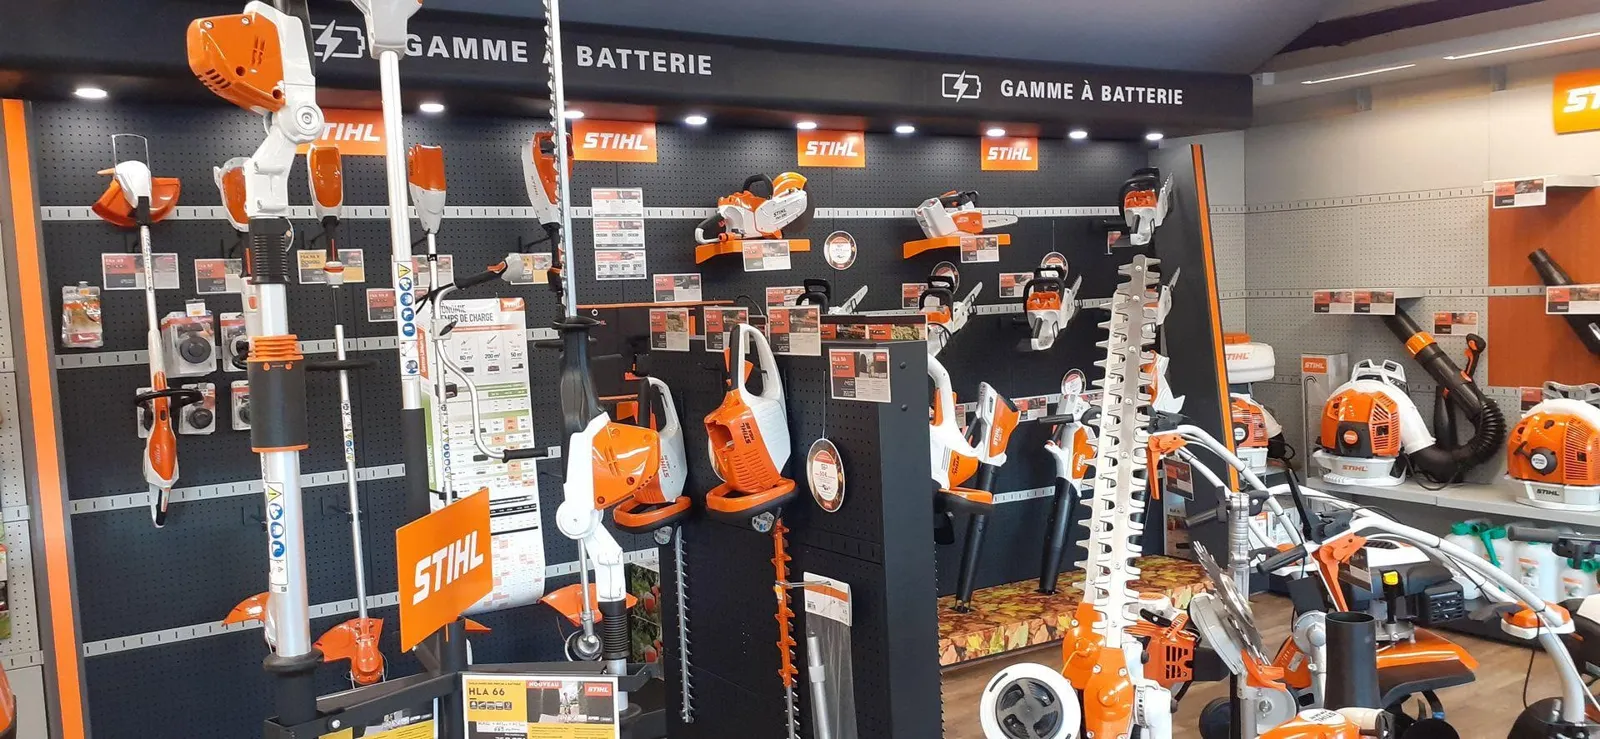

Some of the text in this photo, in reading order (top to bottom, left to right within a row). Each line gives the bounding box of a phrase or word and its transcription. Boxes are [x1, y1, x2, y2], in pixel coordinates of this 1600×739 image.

[404, 34, 528, 63] GAMME
[576, 45, 712, 76] BATTERIE
[1000, 79, 1183, 105] GAMME À BATTERIE
[321, 122, 381, 142] TIHL
[582, 132, 649, 151] STIHL
[805, 140, 858, 157] STIHL
[987, 146, 1032, 161] STIHL
[460, 313, 469, 322] DE
[469, 312, 494, 322] CHARGE
[1304, 361, 1325, 369] STIHL
[740, 422, 751, 444] STIHL
[660, 456, 670, 478] STIHL
[1341, 464, 1368, 472] STIHL
[1536, 488, 1559, 496] STIHL
[412, 530, 484, 605] STIHL
[468, 687, 505, 696] HLA 66
